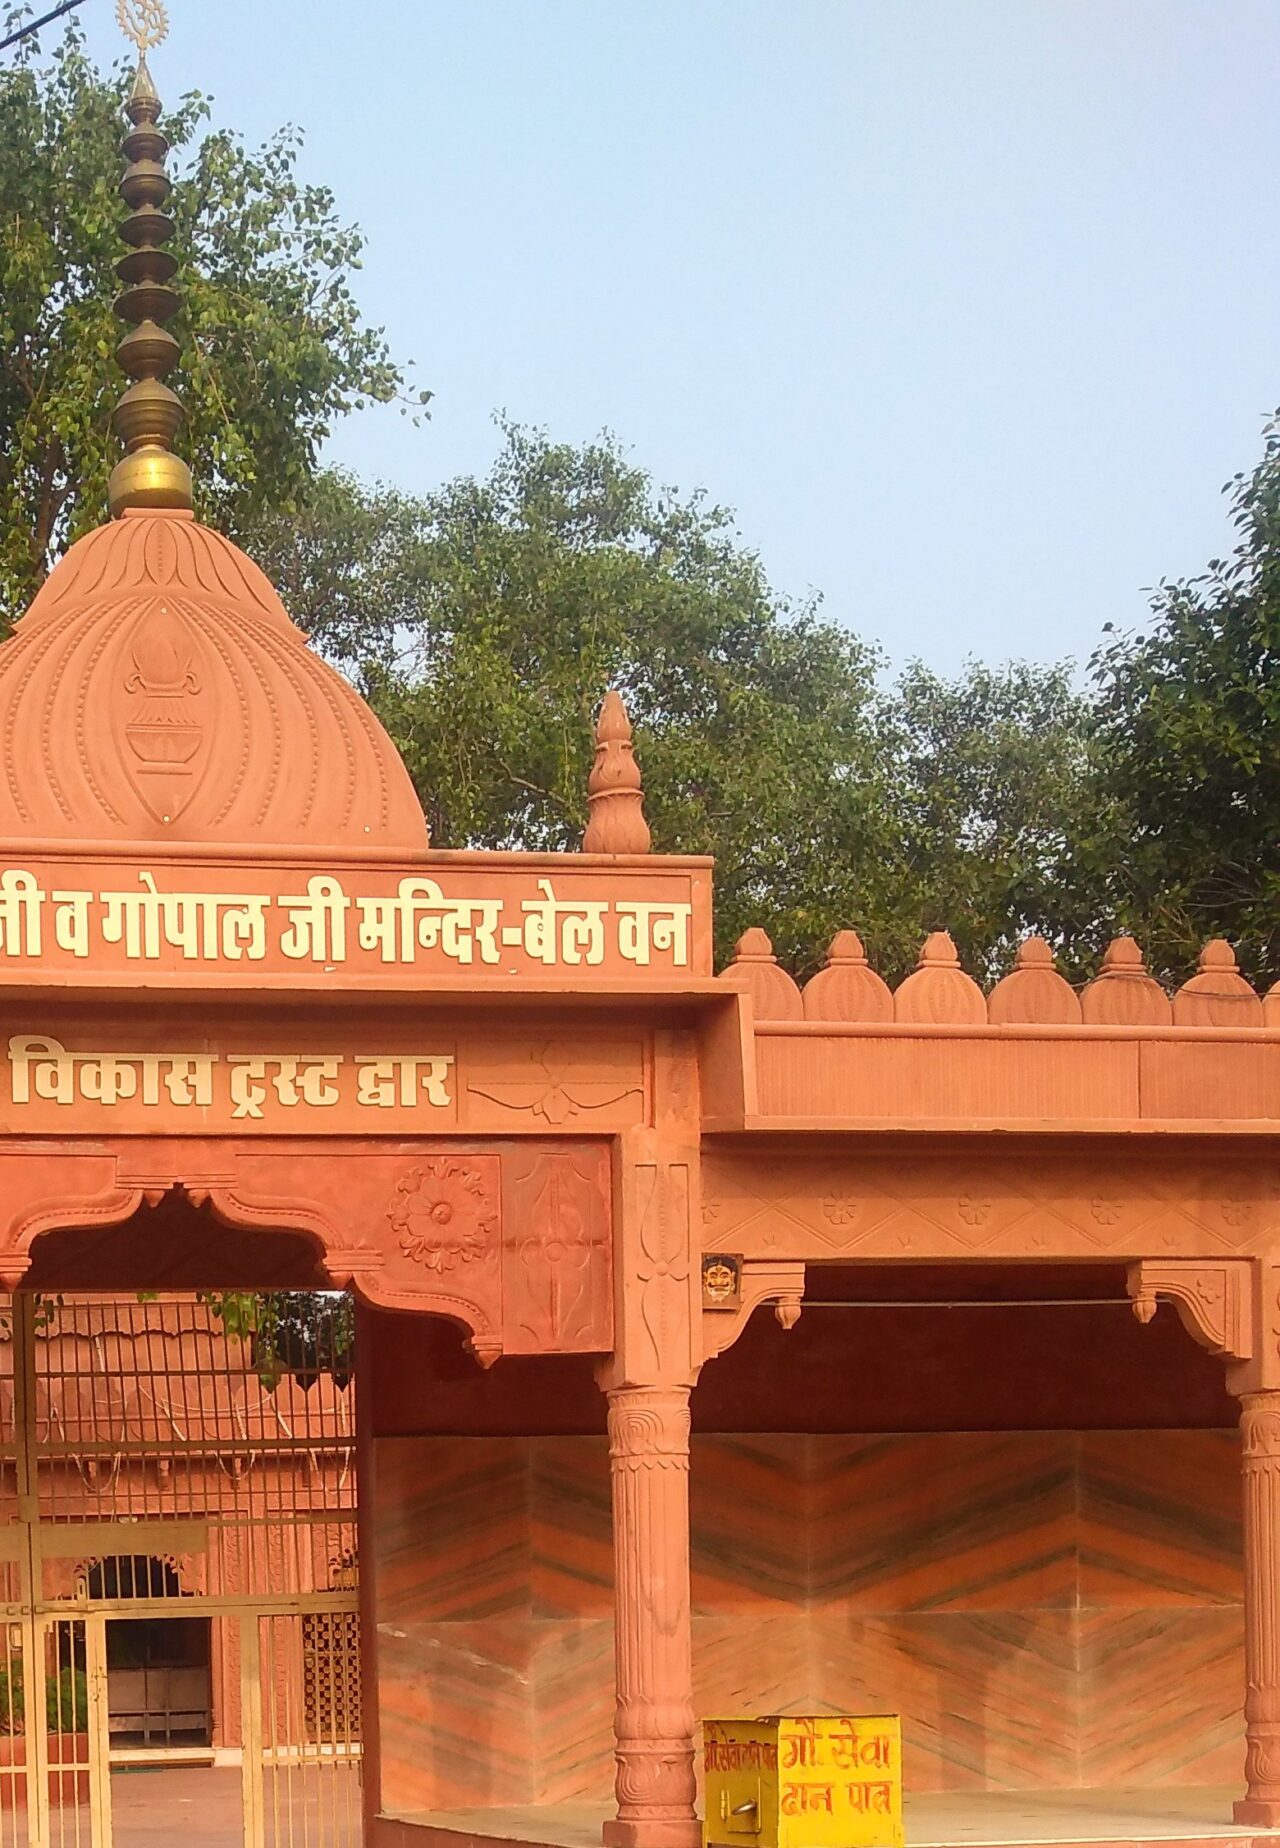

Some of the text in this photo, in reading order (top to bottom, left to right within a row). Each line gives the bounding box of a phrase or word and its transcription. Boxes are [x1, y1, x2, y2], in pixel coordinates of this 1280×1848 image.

[51, 891, 94, 957] व
[100, 871, 271, 960] गोपाल
[277, 875, 351, 961] जी
[615, 900, 693, 966] वन
[8, 1035, 220, 1106] विकास
[227, 1054, 345, 1118] ट्रस्ट
[354, 1054, 456, 1107] द्वार
[828, 1719, 896, 1769] सेवा
[781, 1780, 835, 1816] दान
